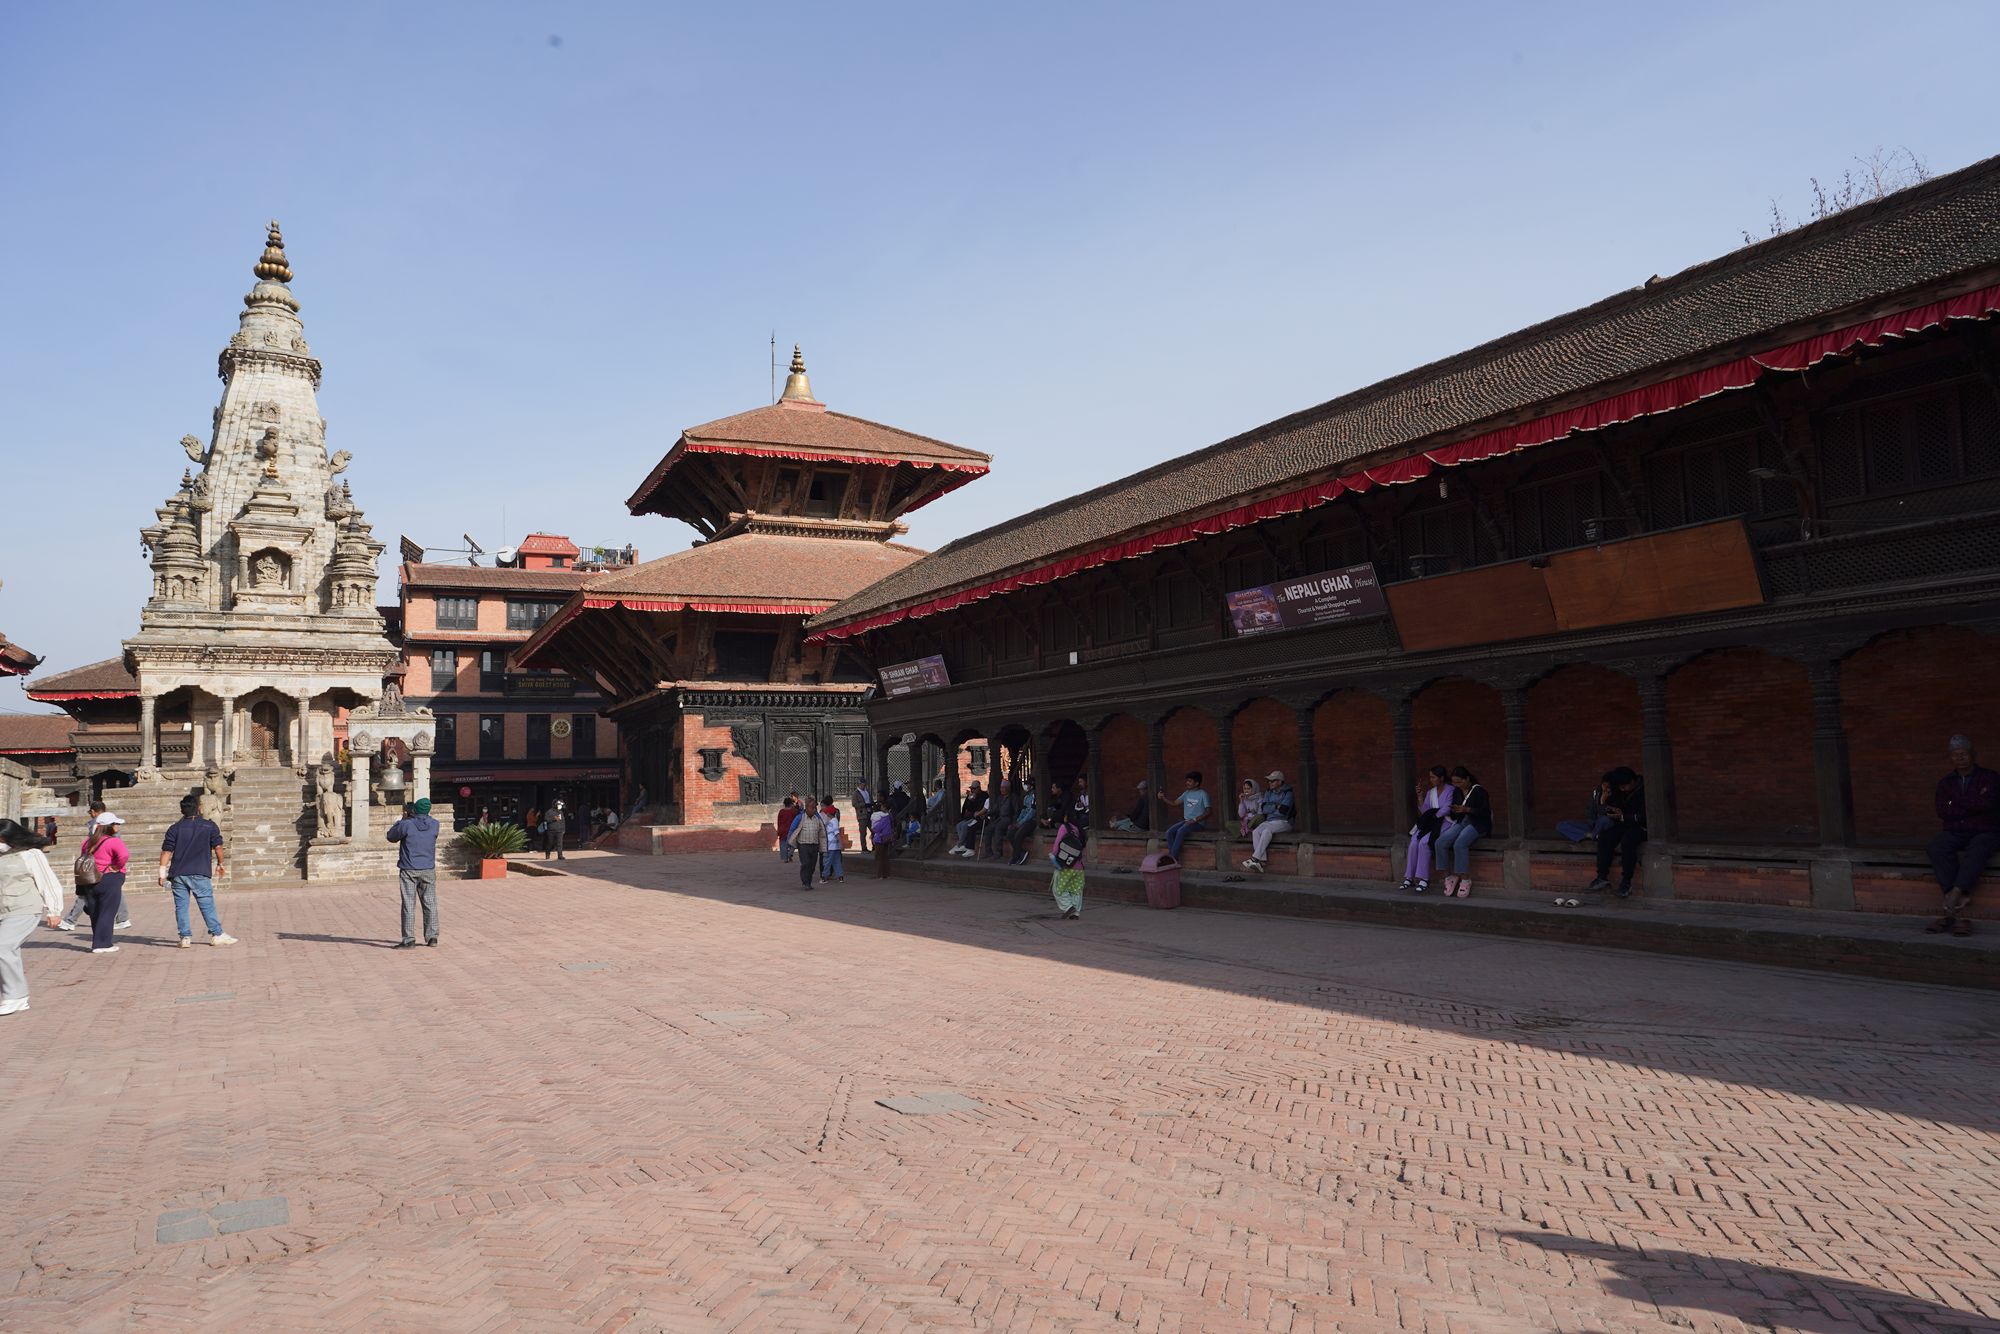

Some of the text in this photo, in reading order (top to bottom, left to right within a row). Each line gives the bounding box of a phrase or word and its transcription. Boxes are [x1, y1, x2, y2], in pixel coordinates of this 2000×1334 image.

[1284, 581, 1321, 600] NEPALI
[1320, 574, 1353, 594] GHAR
[1319, 595, 1337, 604] Complete
[1327, 600, 1346, 610] Shopping
[905, 666, 919, 675] GHAR
